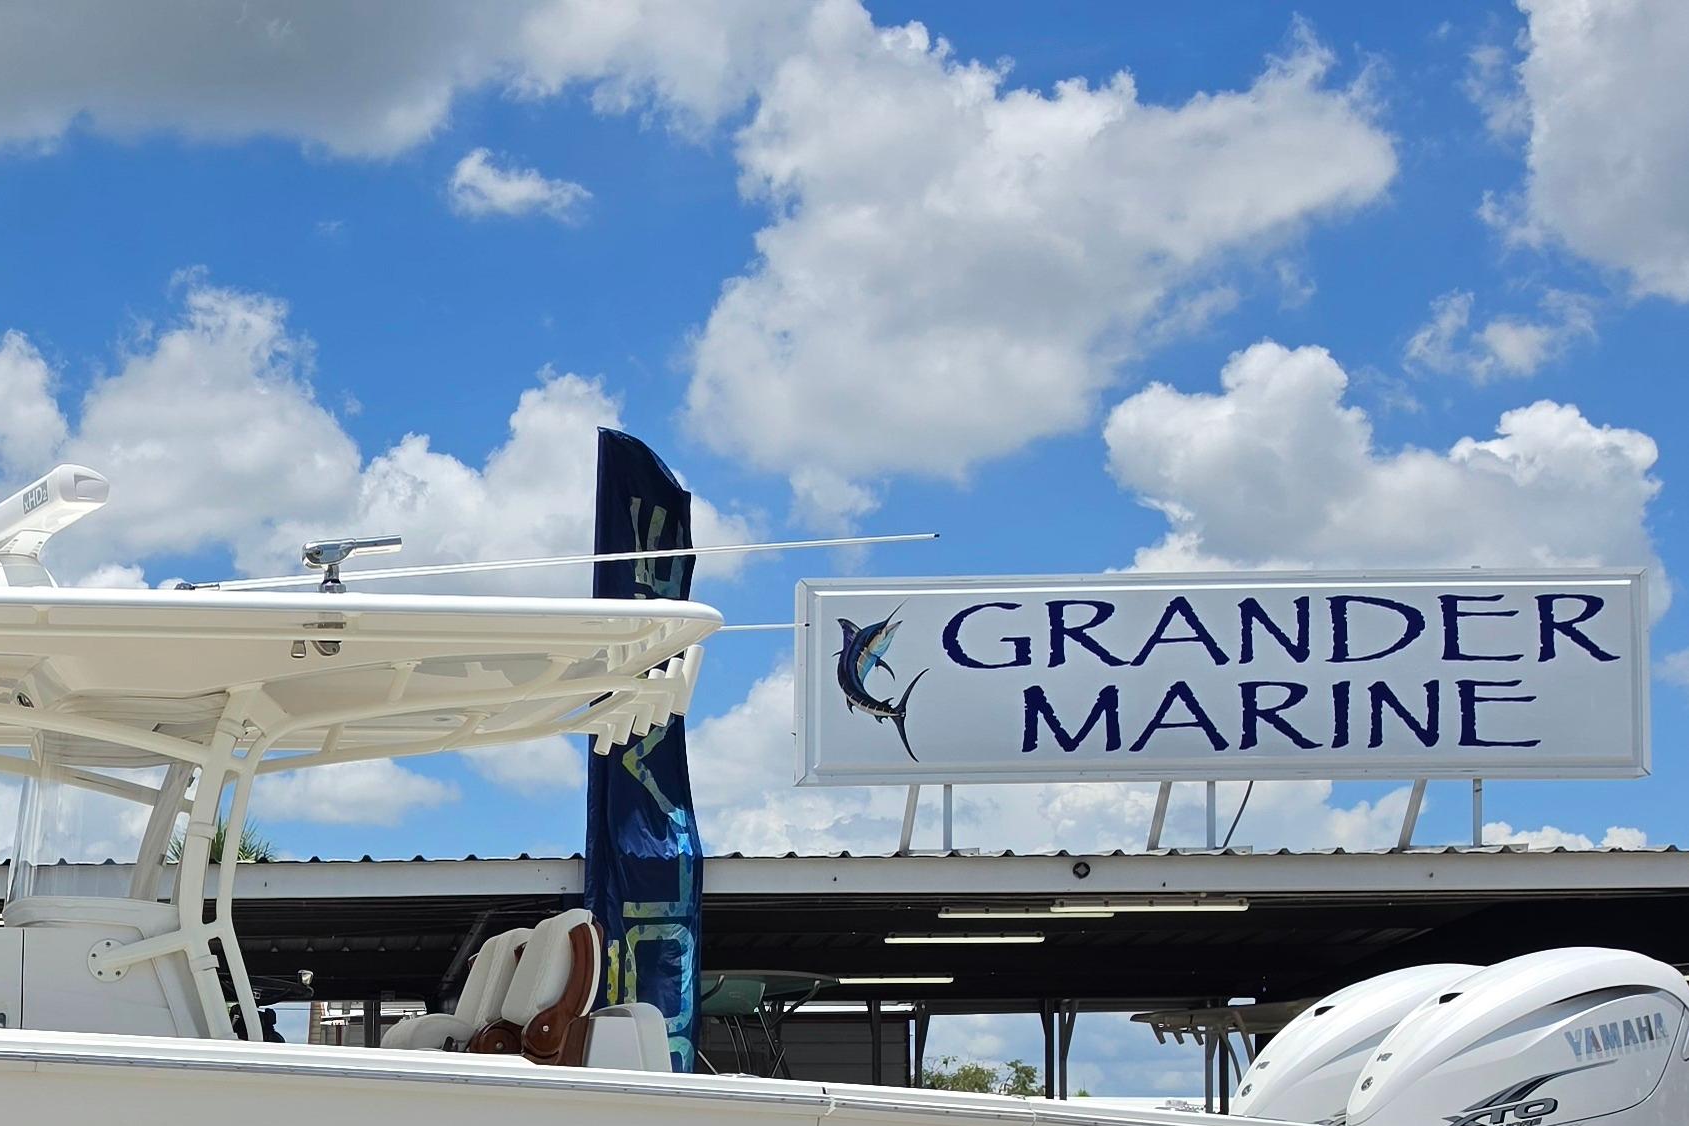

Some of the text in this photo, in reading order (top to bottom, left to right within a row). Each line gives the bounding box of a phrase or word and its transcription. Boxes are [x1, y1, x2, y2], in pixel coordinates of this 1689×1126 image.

[941, 593, 1622, 670] GRANDER
[1020, 679, 1541, 753] MARINE
[1564, 1012, 1669, 1056] YAMAHA
